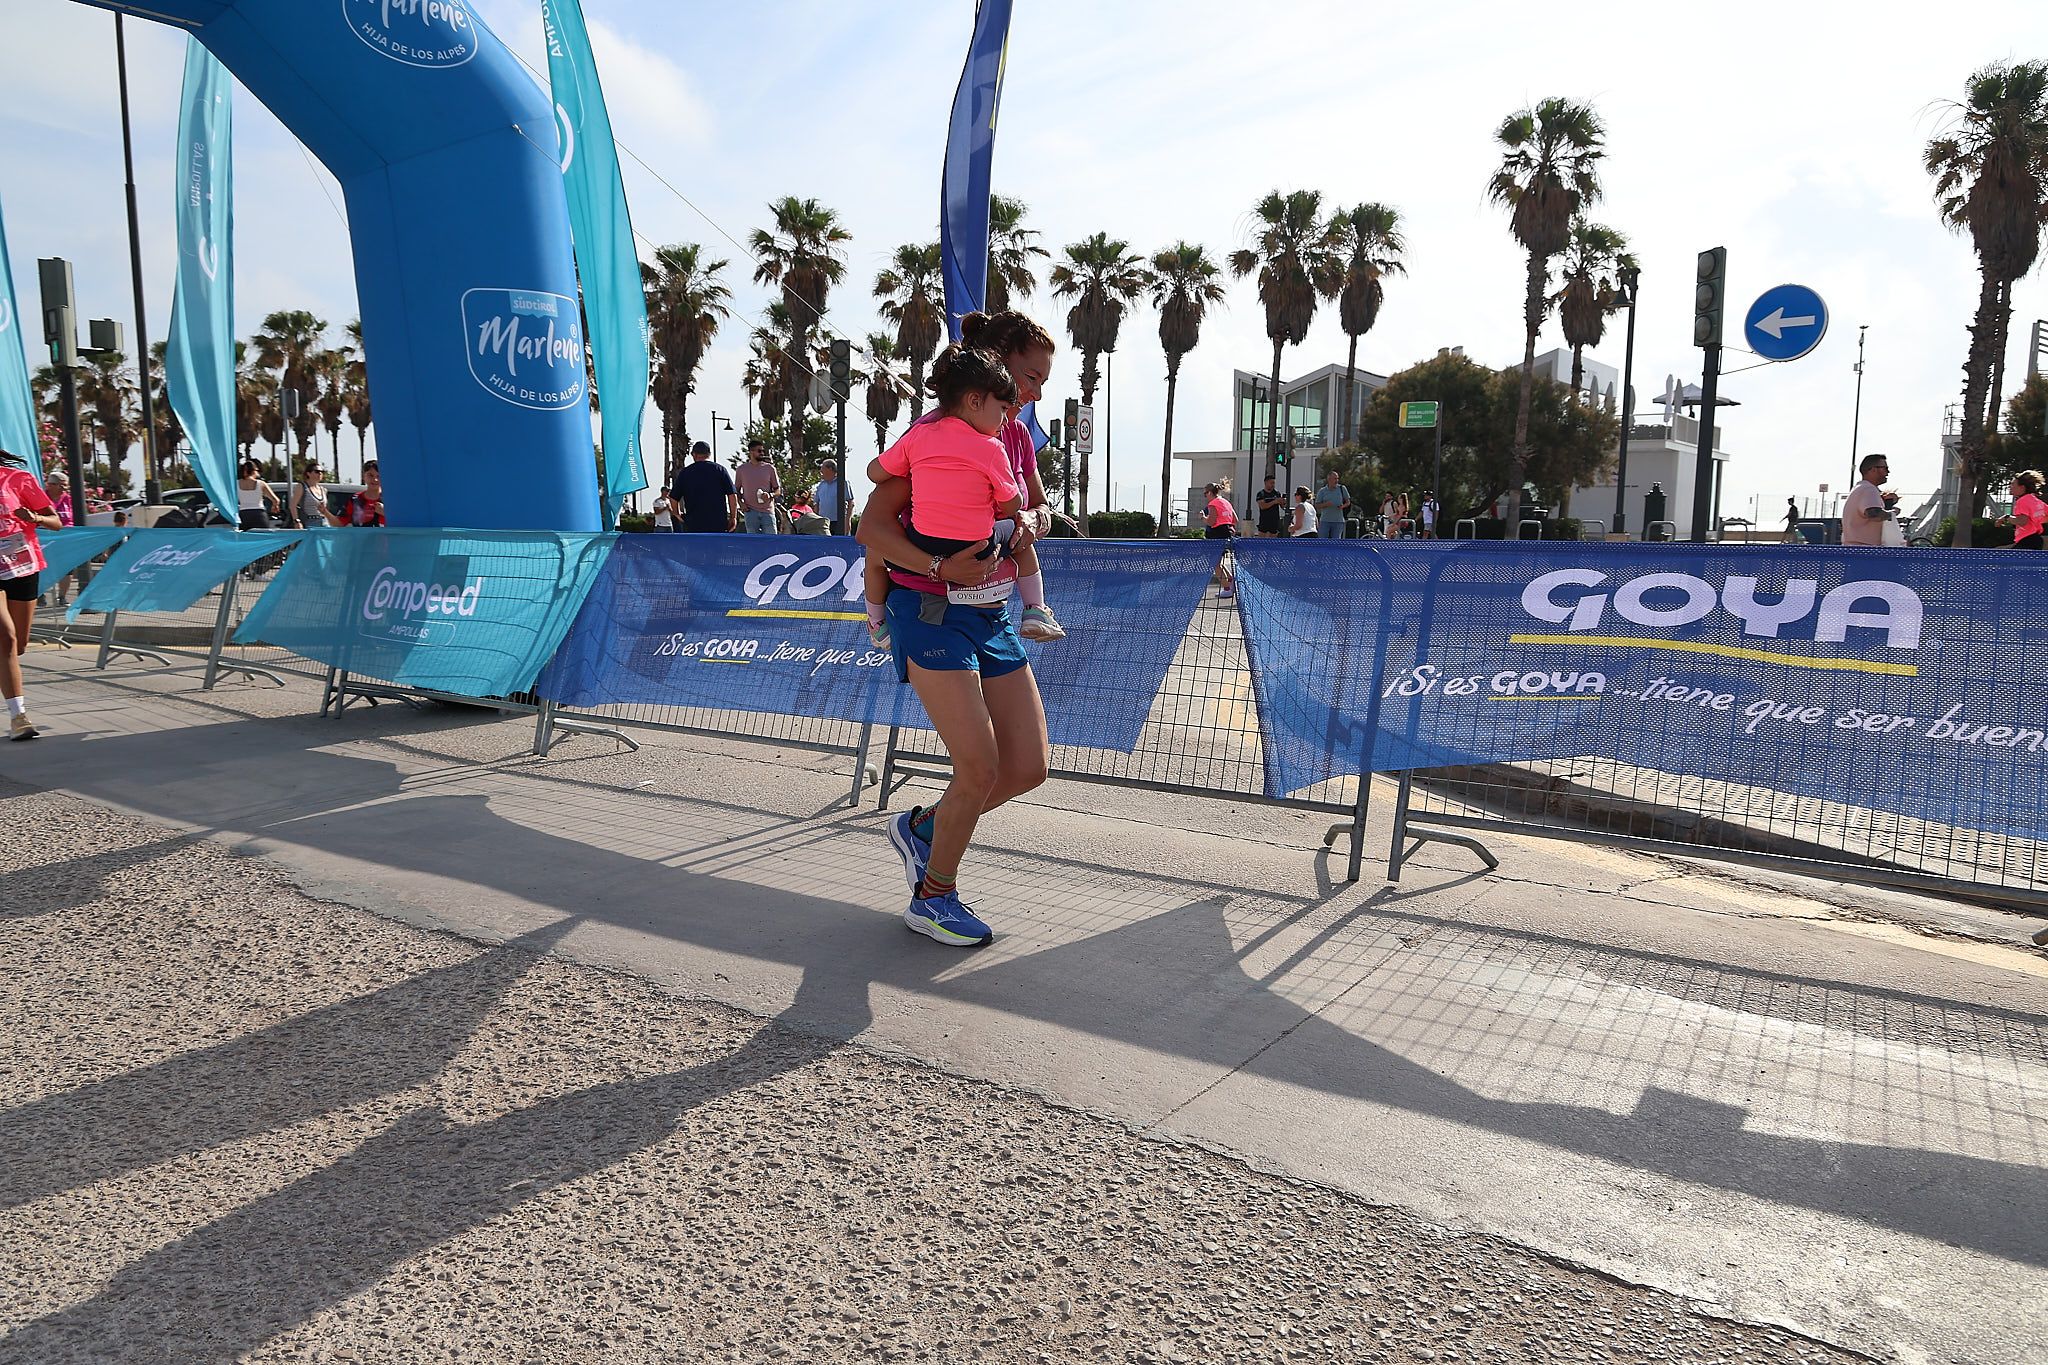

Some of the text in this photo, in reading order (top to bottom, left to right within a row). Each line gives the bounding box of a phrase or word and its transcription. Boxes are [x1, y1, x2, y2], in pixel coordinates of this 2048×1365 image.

[361, 22, 466, 61] HIJA DE LOS ALPES
[542, 0, 564, 57] AMPO
[478, 316, 580, 377] Marlene
[489, 373, 580, 402] HIJA DE LOS ALPES
[628, 456, 638, 481] Cumple
[363, 566, 483, 620] Compeed
[743, 553, 867, 605] GO
[388, 624, 430, 639] AMPOLLAS
[1521, 568, 1924, 650] GOYA
[682, 640, 704, 658] es
[703, 638, 758, 658] GOYA
[809, 648, 855, 677] que
[856, 650, 894, 667] ser
[1443, 674, 1485, 696] es
[1490, 671, 1607, 696] GOYA
[1744, 697, 1825, 734] que
[1835, 706, 1916, 733] ser
[1925, 703, 2048, 752] buen
